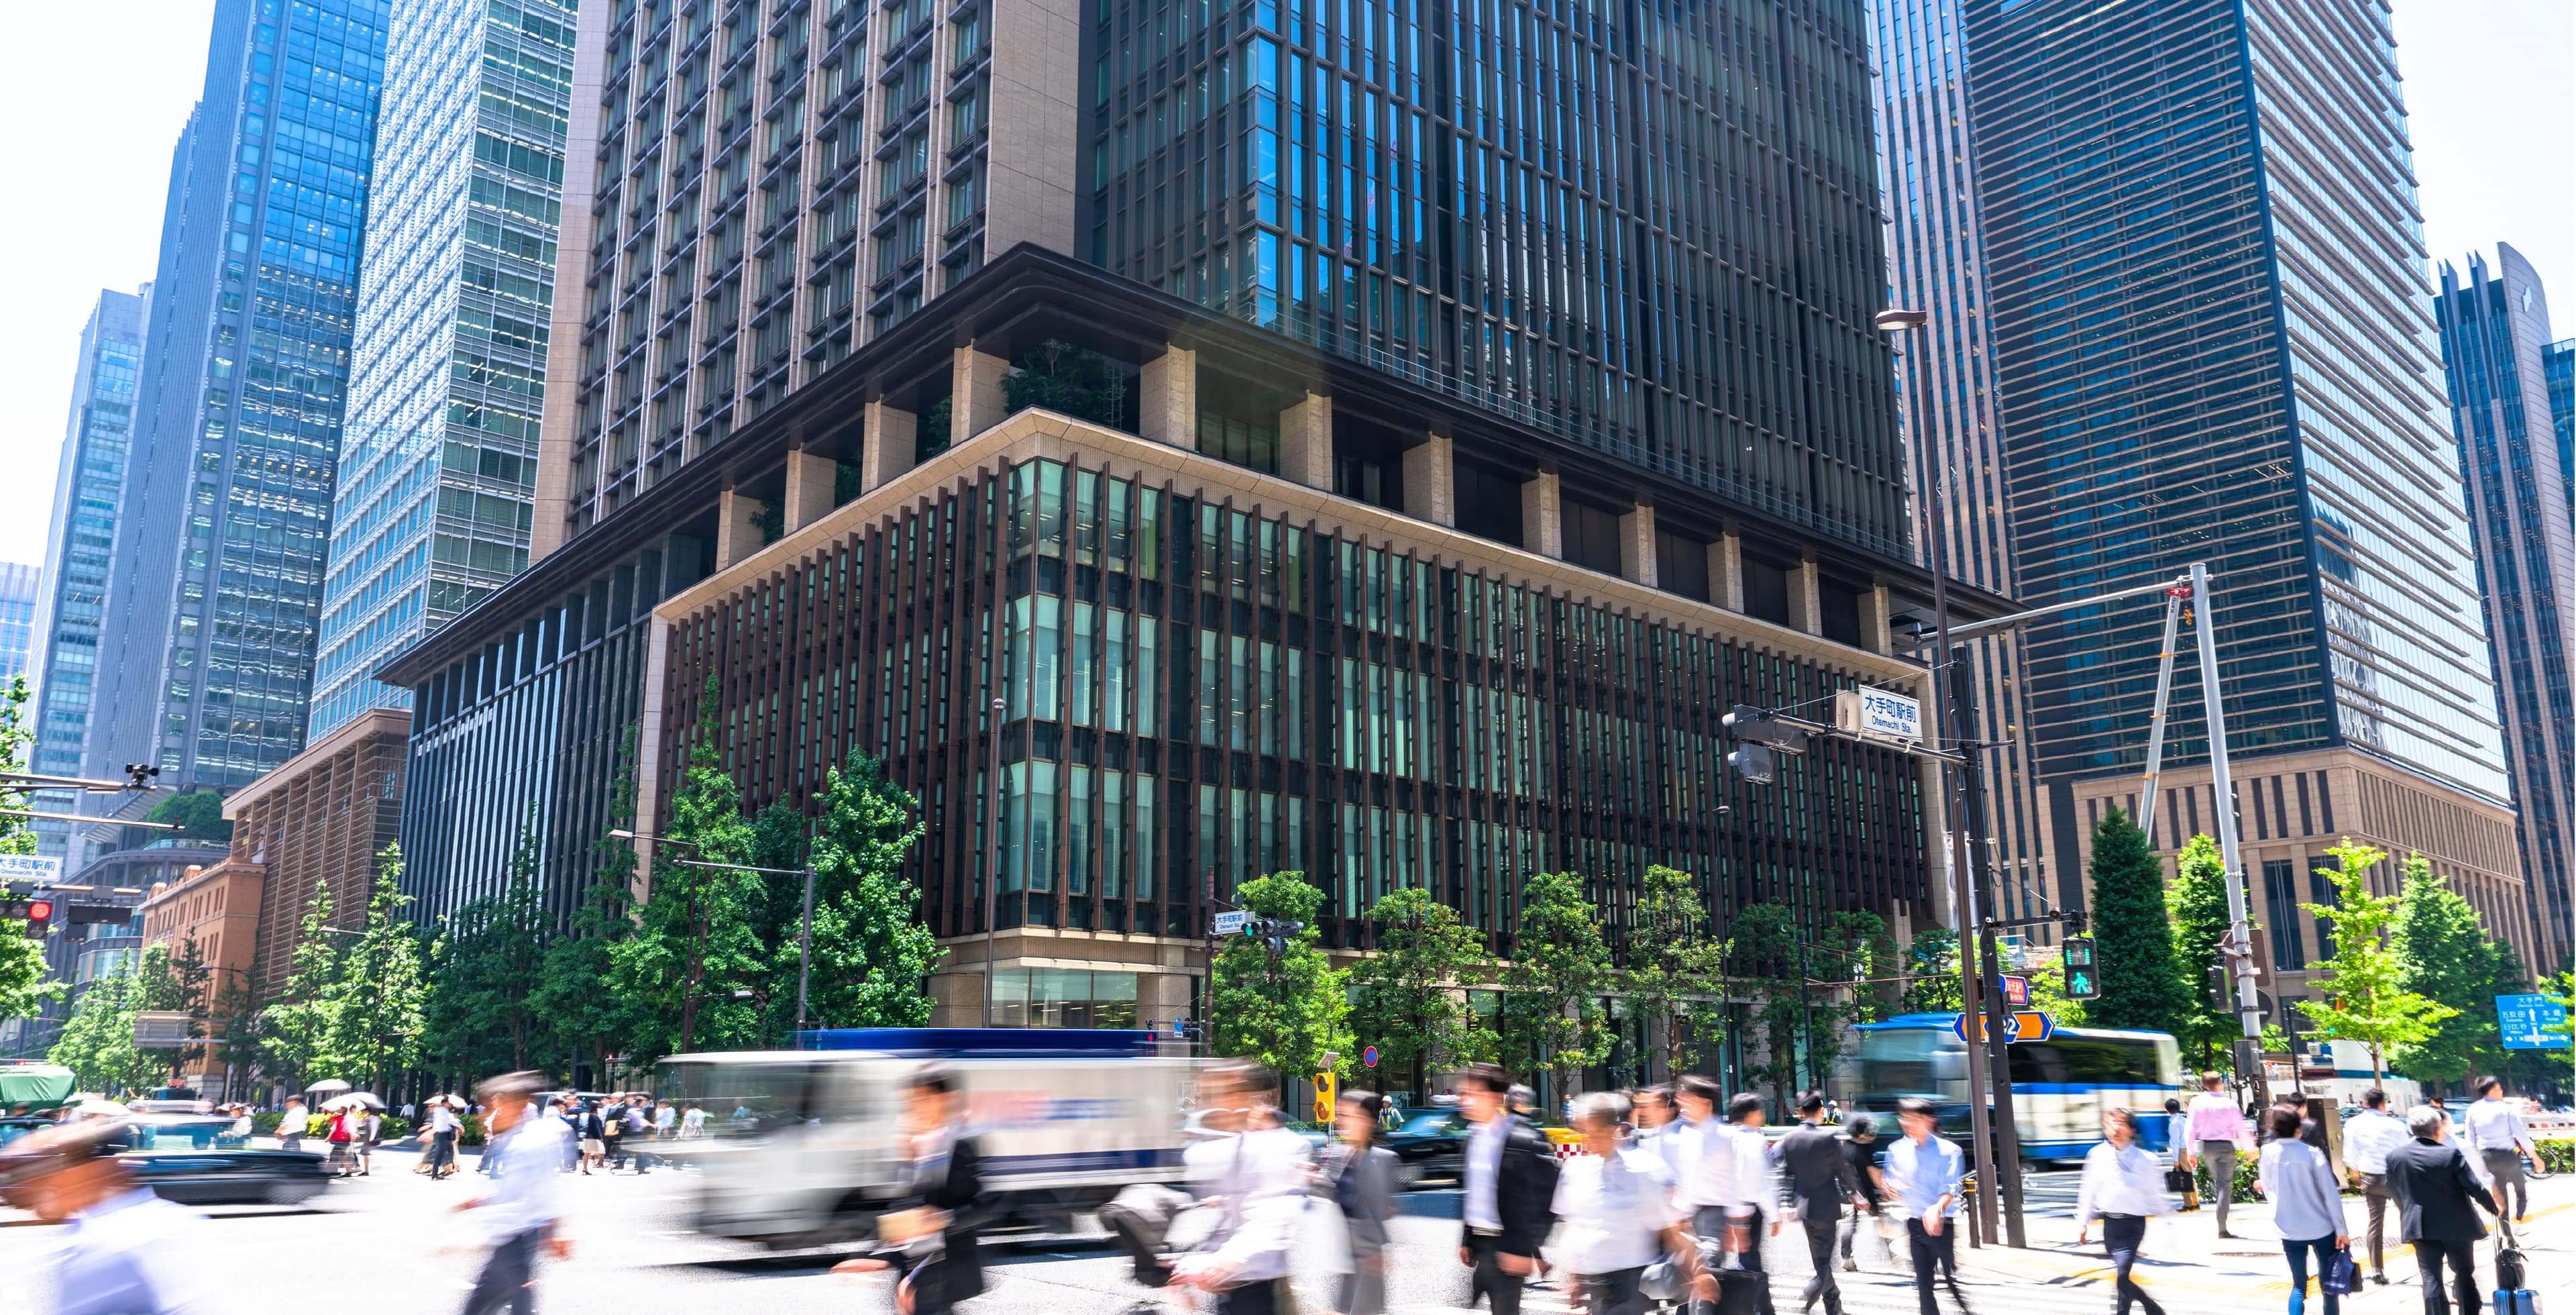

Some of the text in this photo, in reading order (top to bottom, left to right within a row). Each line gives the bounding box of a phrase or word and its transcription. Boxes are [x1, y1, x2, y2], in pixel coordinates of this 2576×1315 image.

[1865, 694, 1917, 723] 大手町駅前
[1872, 715, 1913, 734] Otemachi Sta.
[1217, 914, 1243, 924] 大手町駅前
